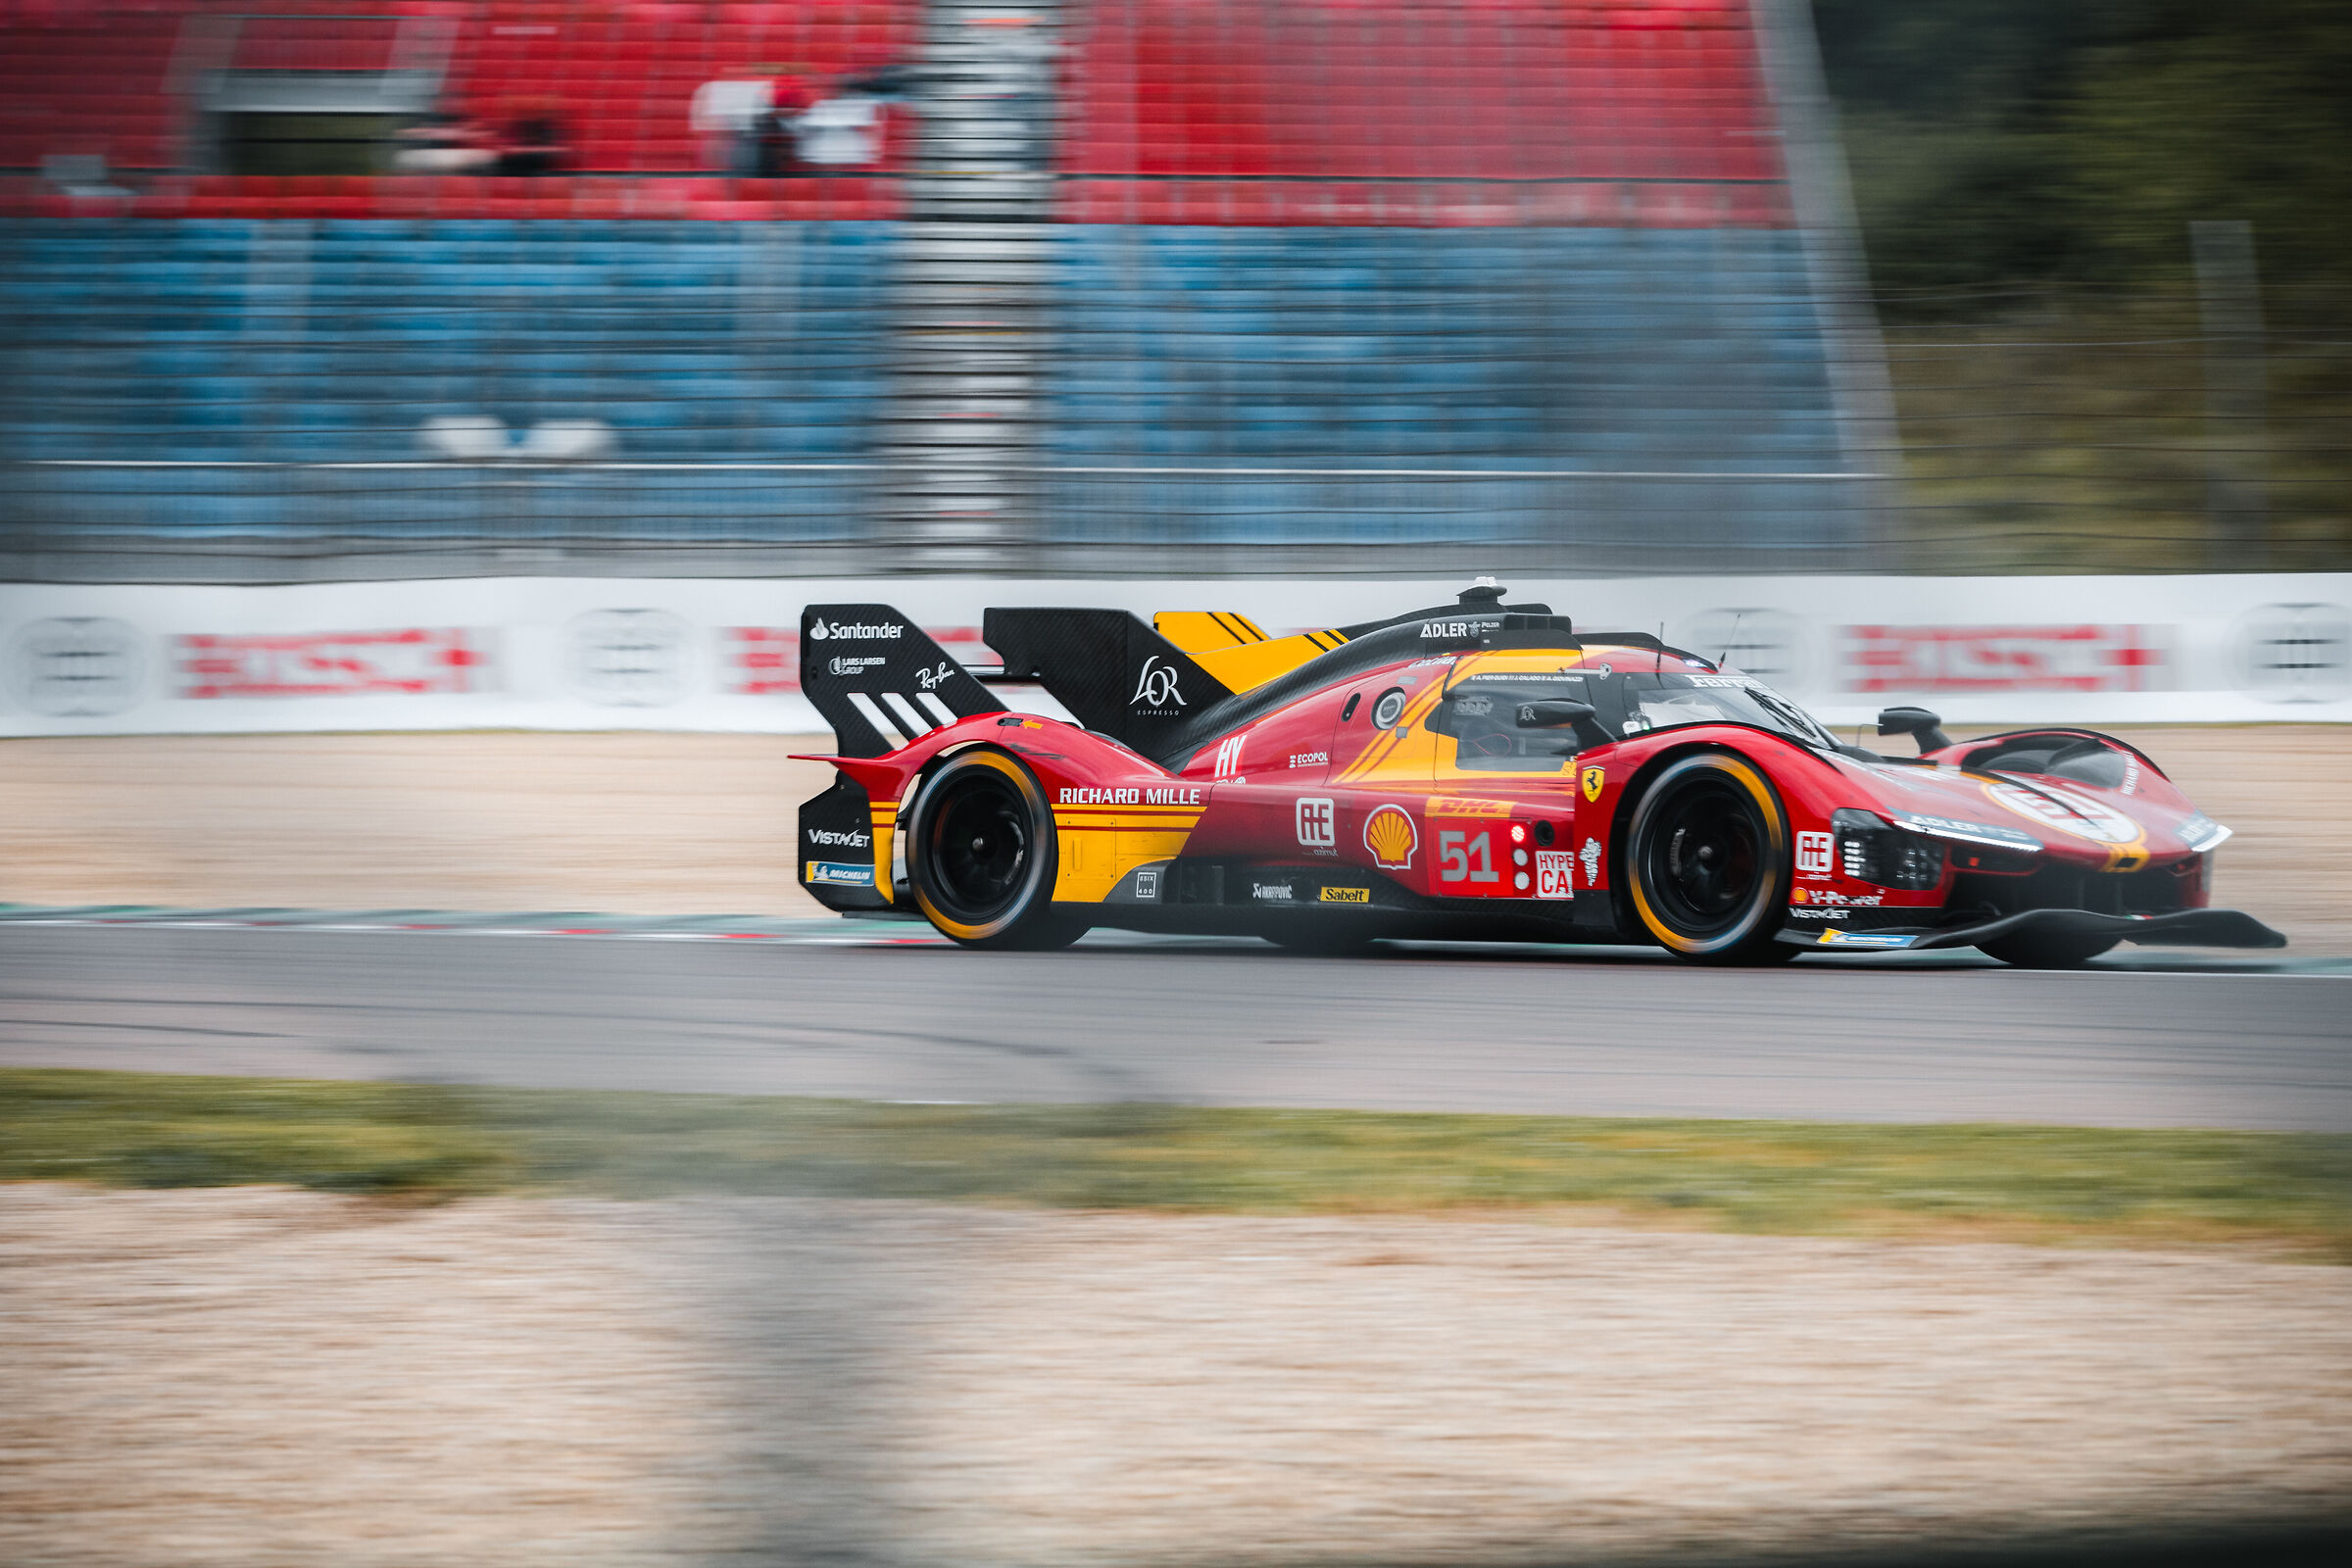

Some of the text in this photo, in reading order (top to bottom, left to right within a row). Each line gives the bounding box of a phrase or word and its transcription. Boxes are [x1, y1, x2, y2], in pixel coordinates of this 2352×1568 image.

[829, 621, 904, 640] Santander
[1420, 622, 1467, 638] ADLER
[859, 657, 886, 665] LARSEN
[914, 662, 956, 689] Ray-Ban
[1214, 735, 1247, 777] HY
[1298, 752, 1328, 763] ECOPOL
[1059, 787, 1201, 805] RICHARD MILLE
[1437, 799, 1500, 813] DHL
[808, 829, 870, 848] VISTAJET
[1439, 830, 1499, 882] 51
[829, 869, 871, 880] MICHELIN
[1542, 870, 1573, 894] CA
[1326, 888, 1364, 902] Sabelt
